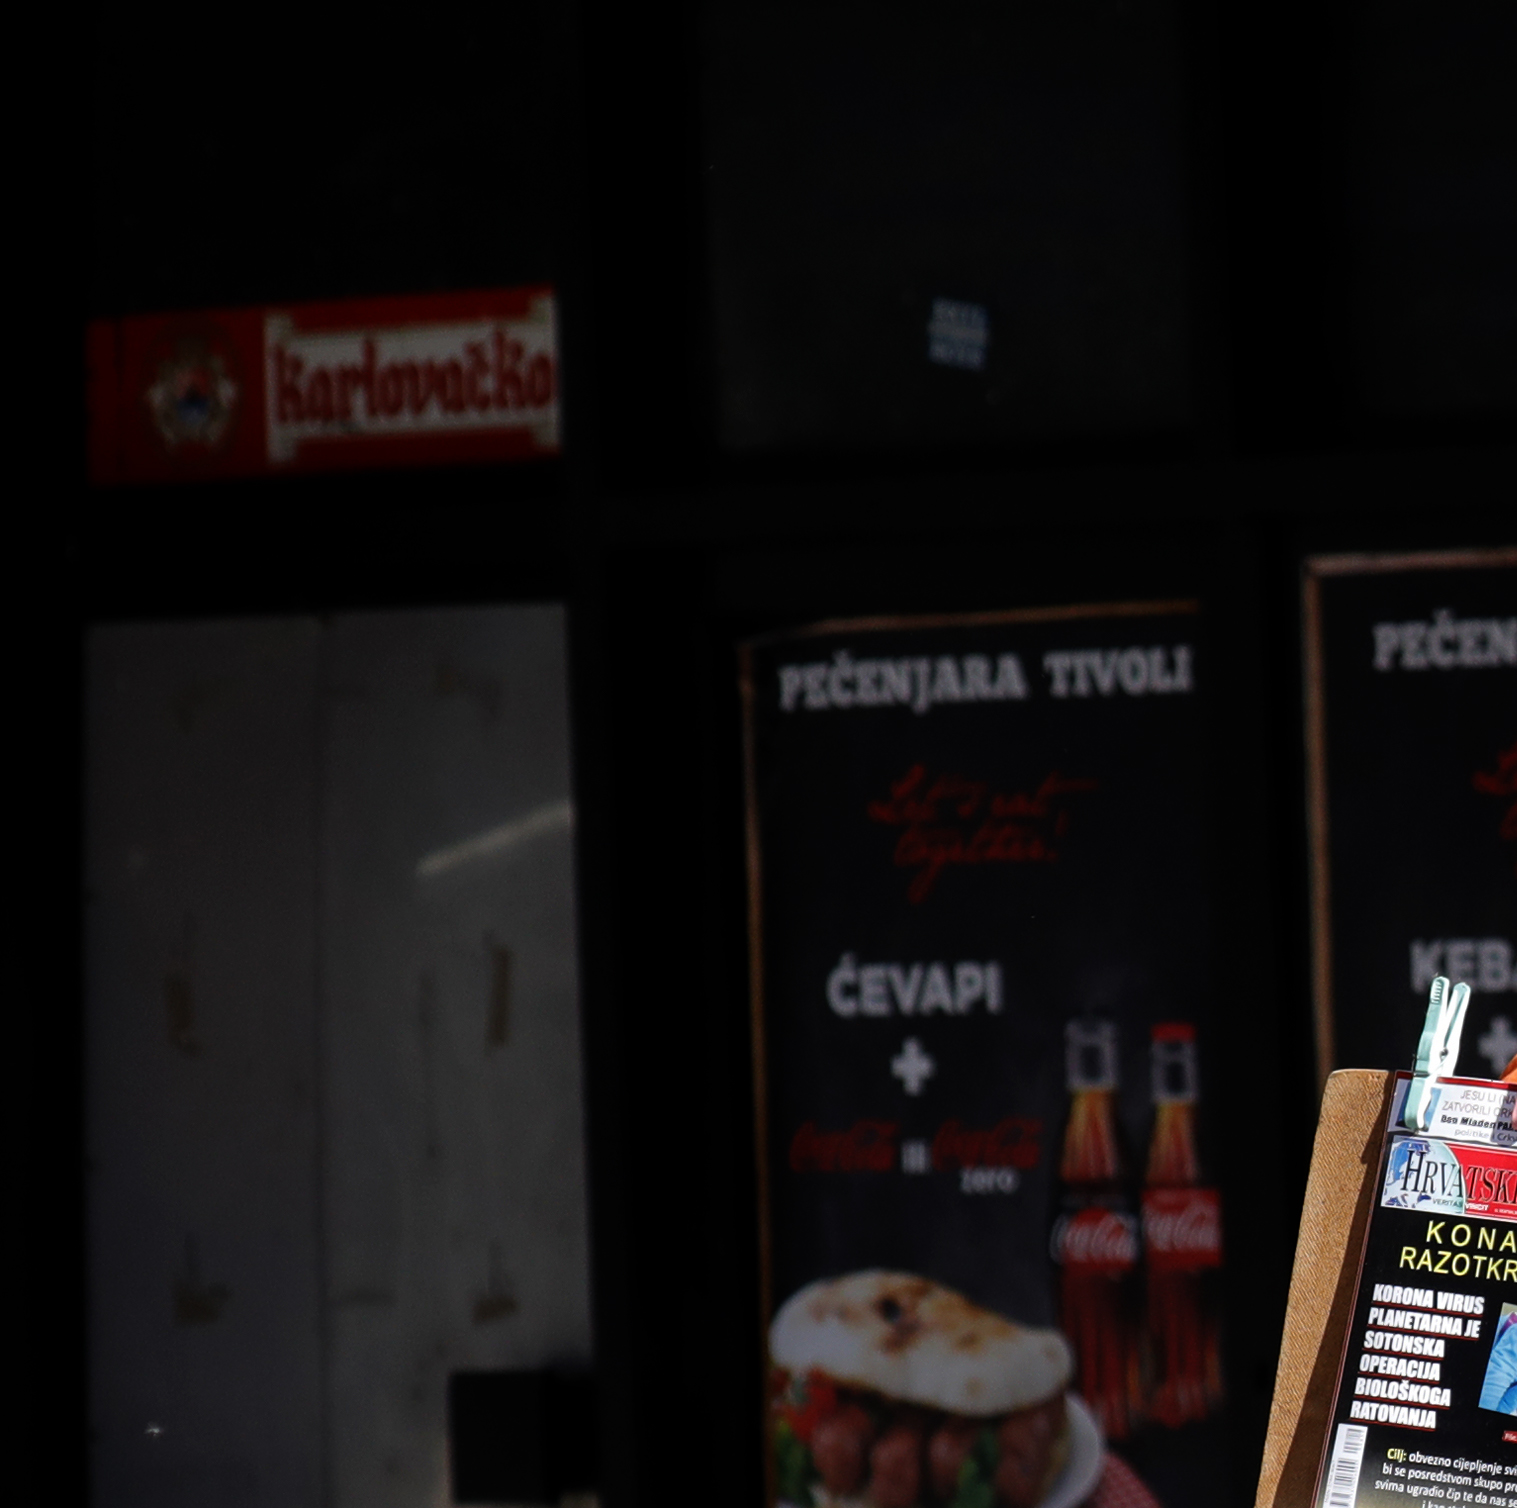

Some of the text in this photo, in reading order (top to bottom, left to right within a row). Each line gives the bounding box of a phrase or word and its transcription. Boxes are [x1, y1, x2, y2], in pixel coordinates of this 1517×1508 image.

[777, 644, 1195, 716] PEČENJARA TIVOLI
[959, 1164, 1019, 1195] zero
[1373, 1284, 1485, 1315] KORONA VIRUS
[1368, 1307, 1481, 1338] PLANETARNA JE
[1364, 1330, 1445, 1358] SOTONSKA
[1359, 1354, 1440, 1381] OPERACIJA
[1355, 1377, 1451, 1407] BIOLOŠKOGA
[1350, 1401, 1436, 1429] RATOVANJA
[1387, 1448, 1407, 1462] Cilj:
[1409, 1453, 1450, 1467] obvezno
[1453, 1458, 1502, 1476] cijepljenje
[1382, 1463, 1392, 1475] bi
[1395, 1468, 1405, 1477] se
[1408, 1468, 1472, 1486] posredstvom
[1474, 1478, 1502, 1491] skupo
